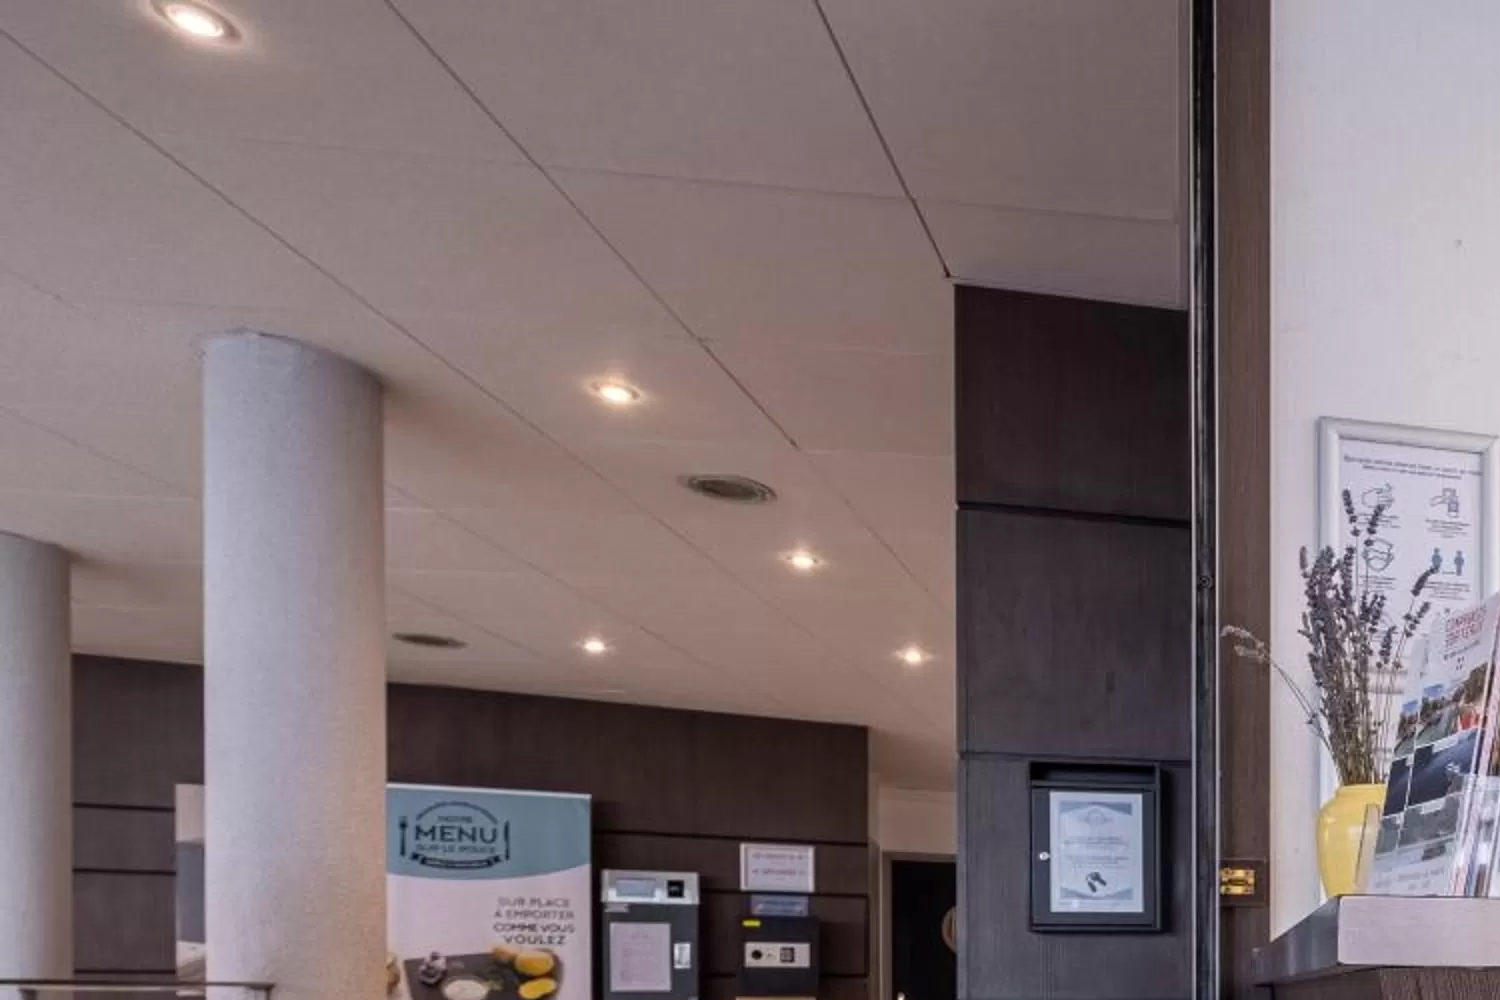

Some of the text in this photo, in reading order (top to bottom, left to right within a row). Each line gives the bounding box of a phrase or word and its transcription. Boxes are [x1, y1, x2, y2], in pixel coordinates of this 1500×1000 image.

[415, 825, 497, 844] MENU
[498, 896, 570, 908] SUR PLACE
[505, 909, 575, 920] EMPORTER
[493, 922, 576, 934] COMME VOUS
[503, 934, 567, 945] VOULEZ
